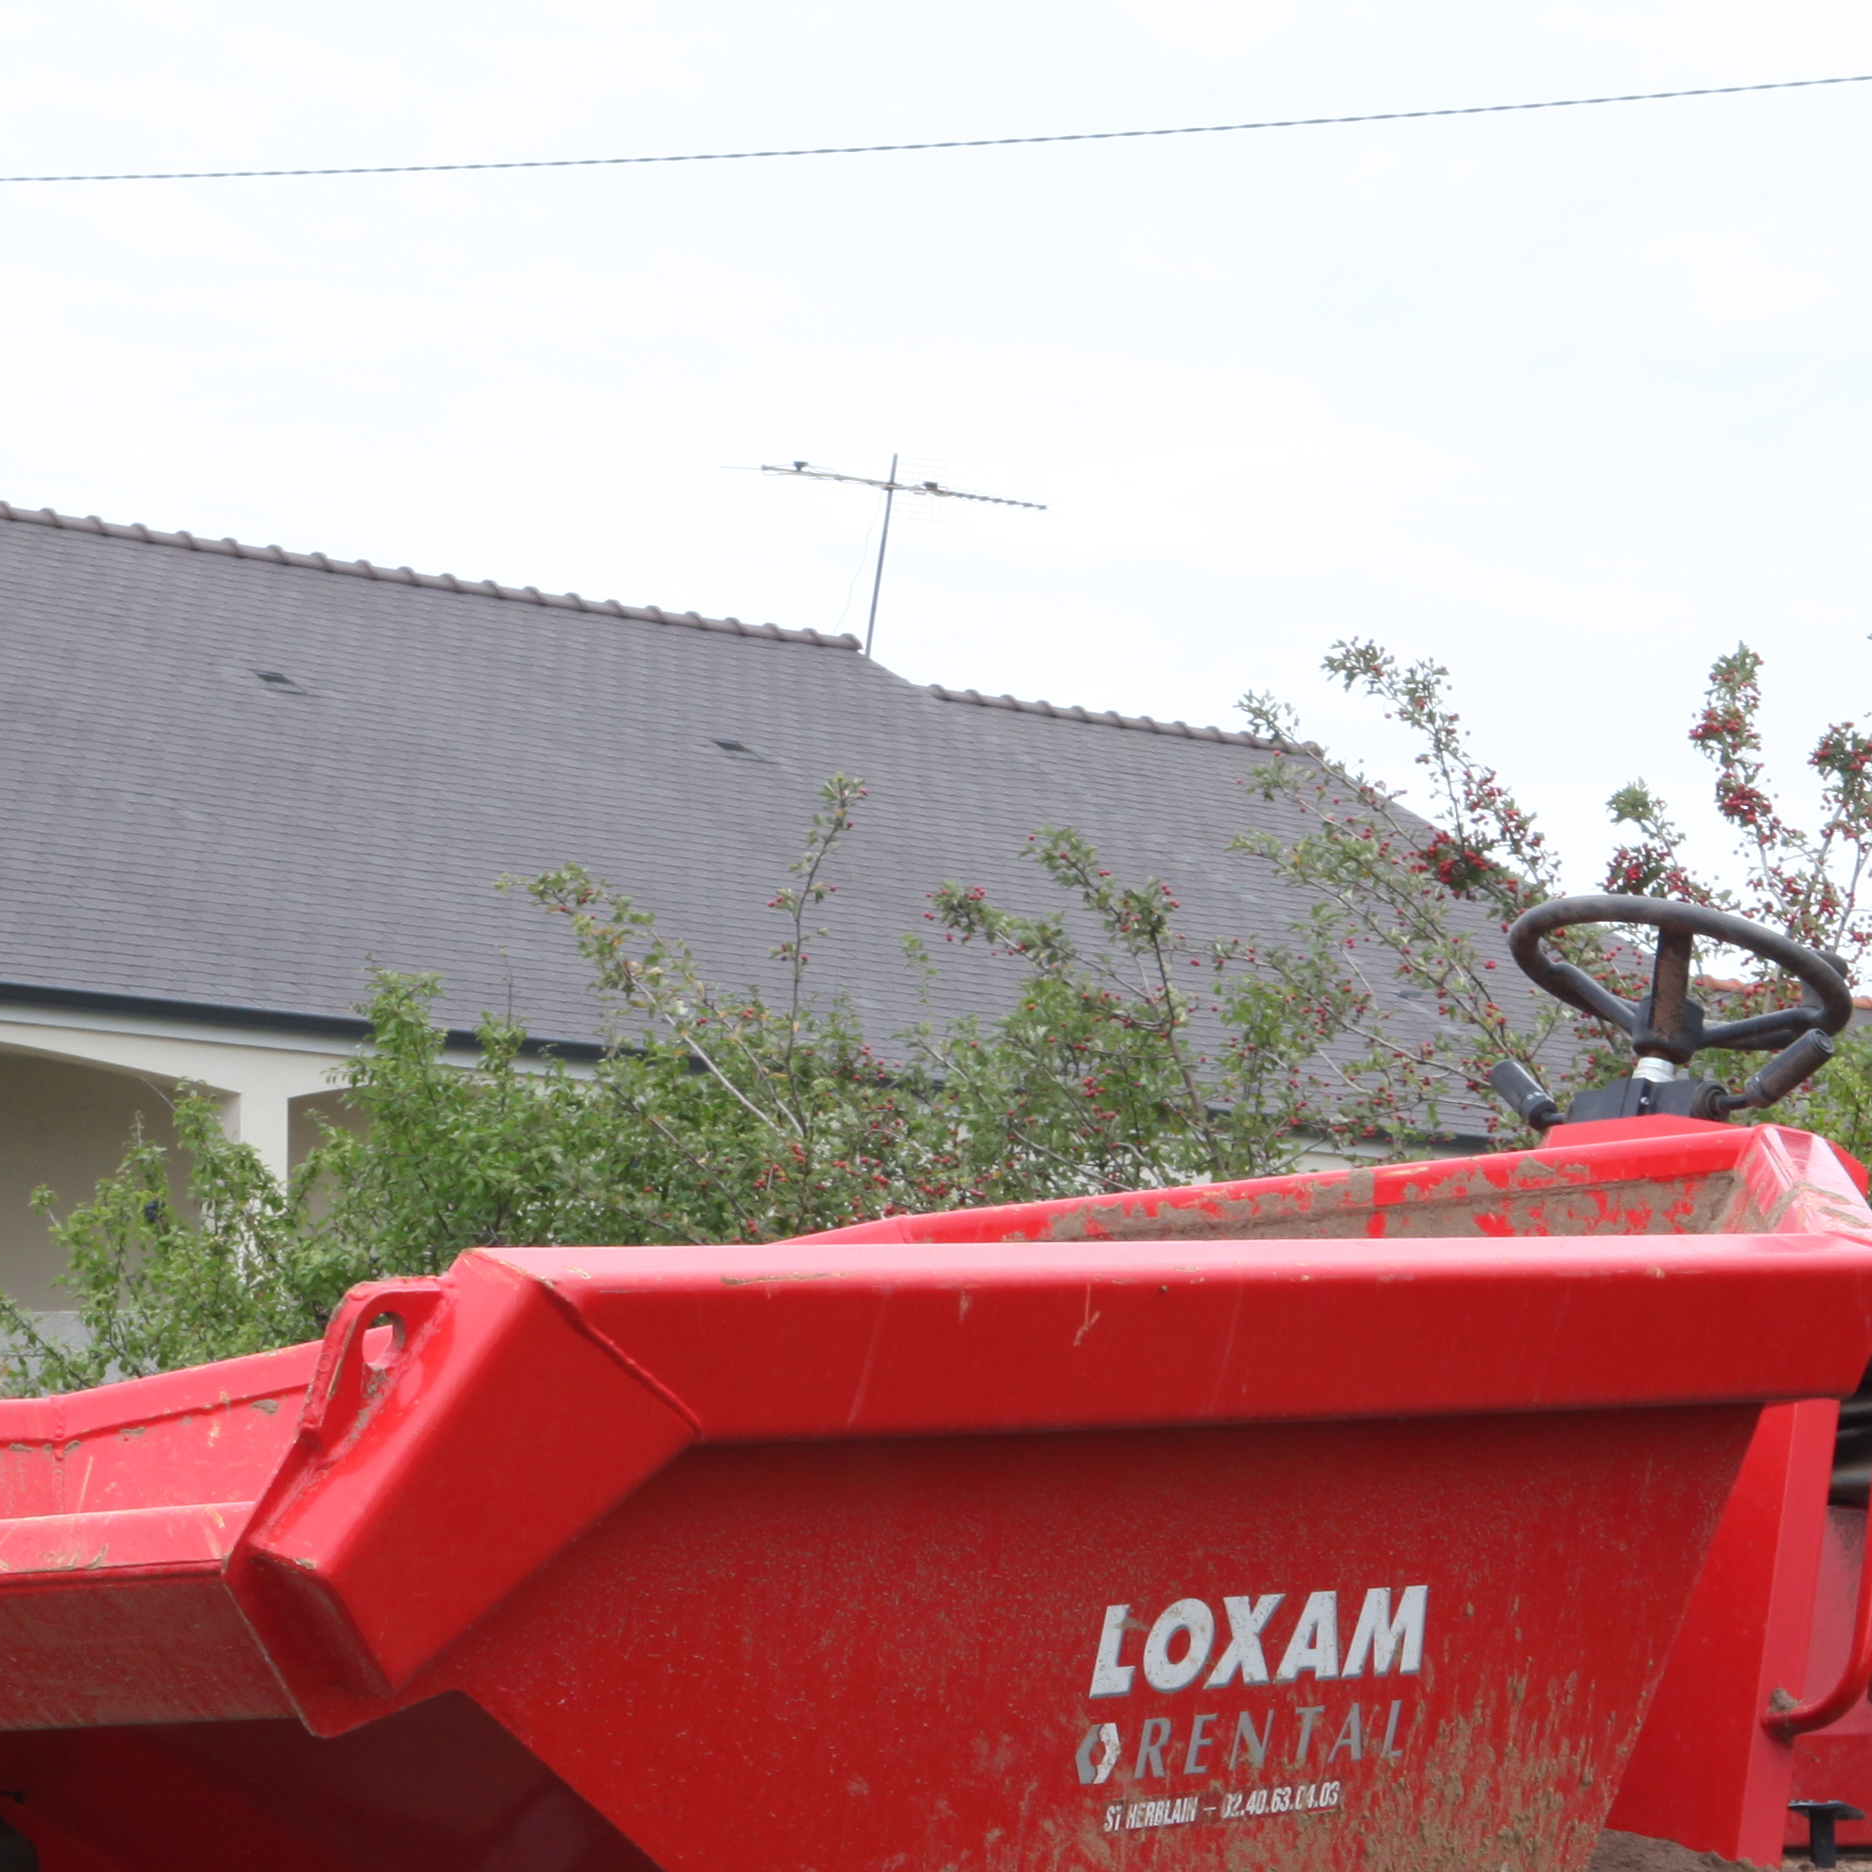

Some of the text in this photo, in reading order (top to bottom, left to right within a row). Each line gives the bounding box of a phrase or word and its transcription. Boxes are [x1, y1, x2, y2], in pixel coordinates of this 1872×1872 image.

[1089, 1585, 1428, 1699] LOXAM
[1134, 1700, 1404, 1779] RENTAL
[1103, 1804, 1123, 1832] ST
[1126, 1796, 1199, 1829] HERBLAIN
